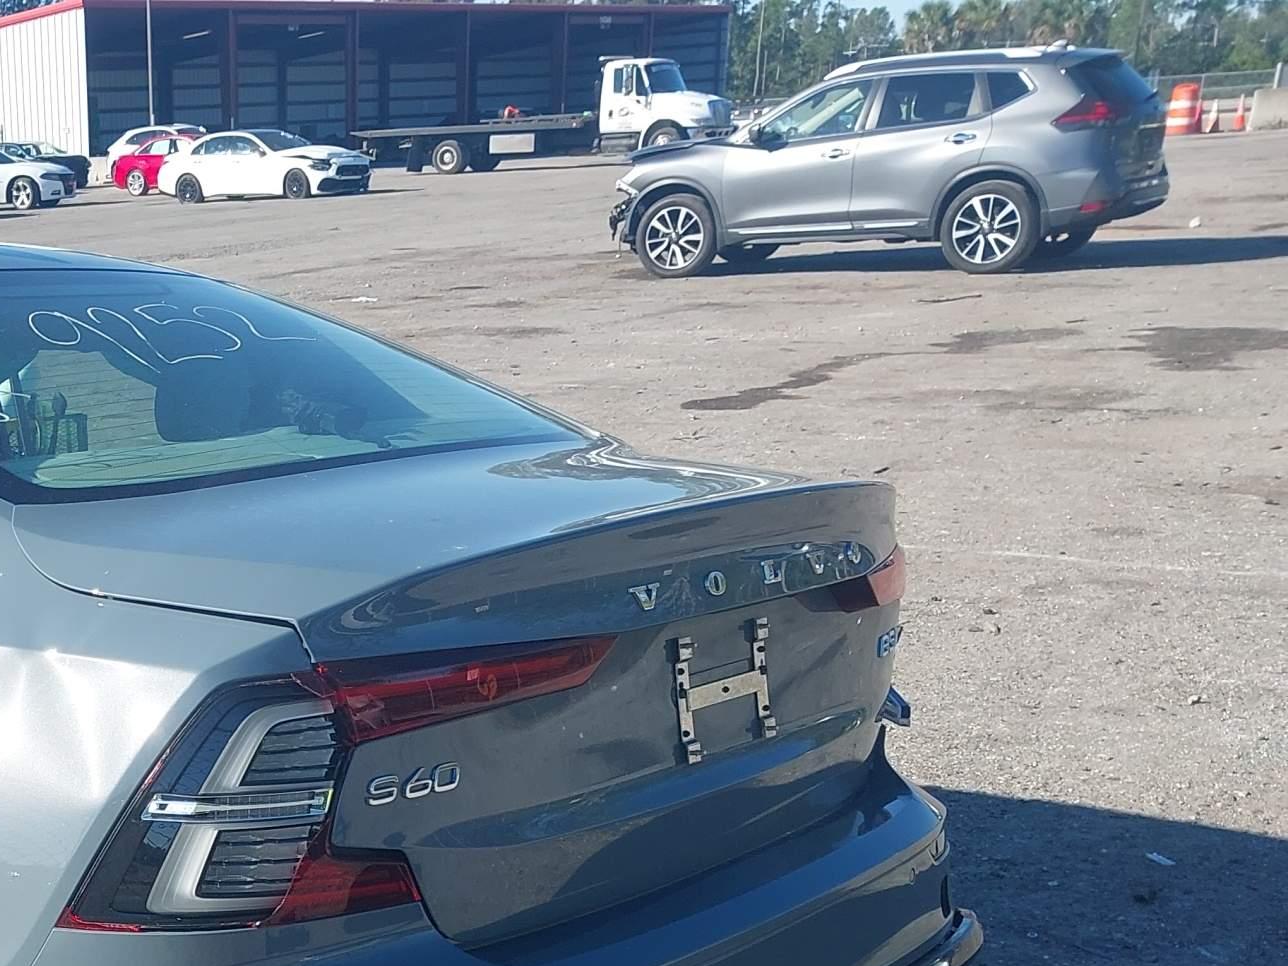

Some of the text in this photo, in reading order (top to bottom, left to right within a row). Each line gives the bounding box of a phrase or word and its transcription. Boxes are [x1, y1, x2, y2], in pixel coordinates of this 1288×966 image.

[28, 300, 317, 374] 9252
[628, 540, 863, 612] VOLVO
[365, 761, 460, 806] S60
